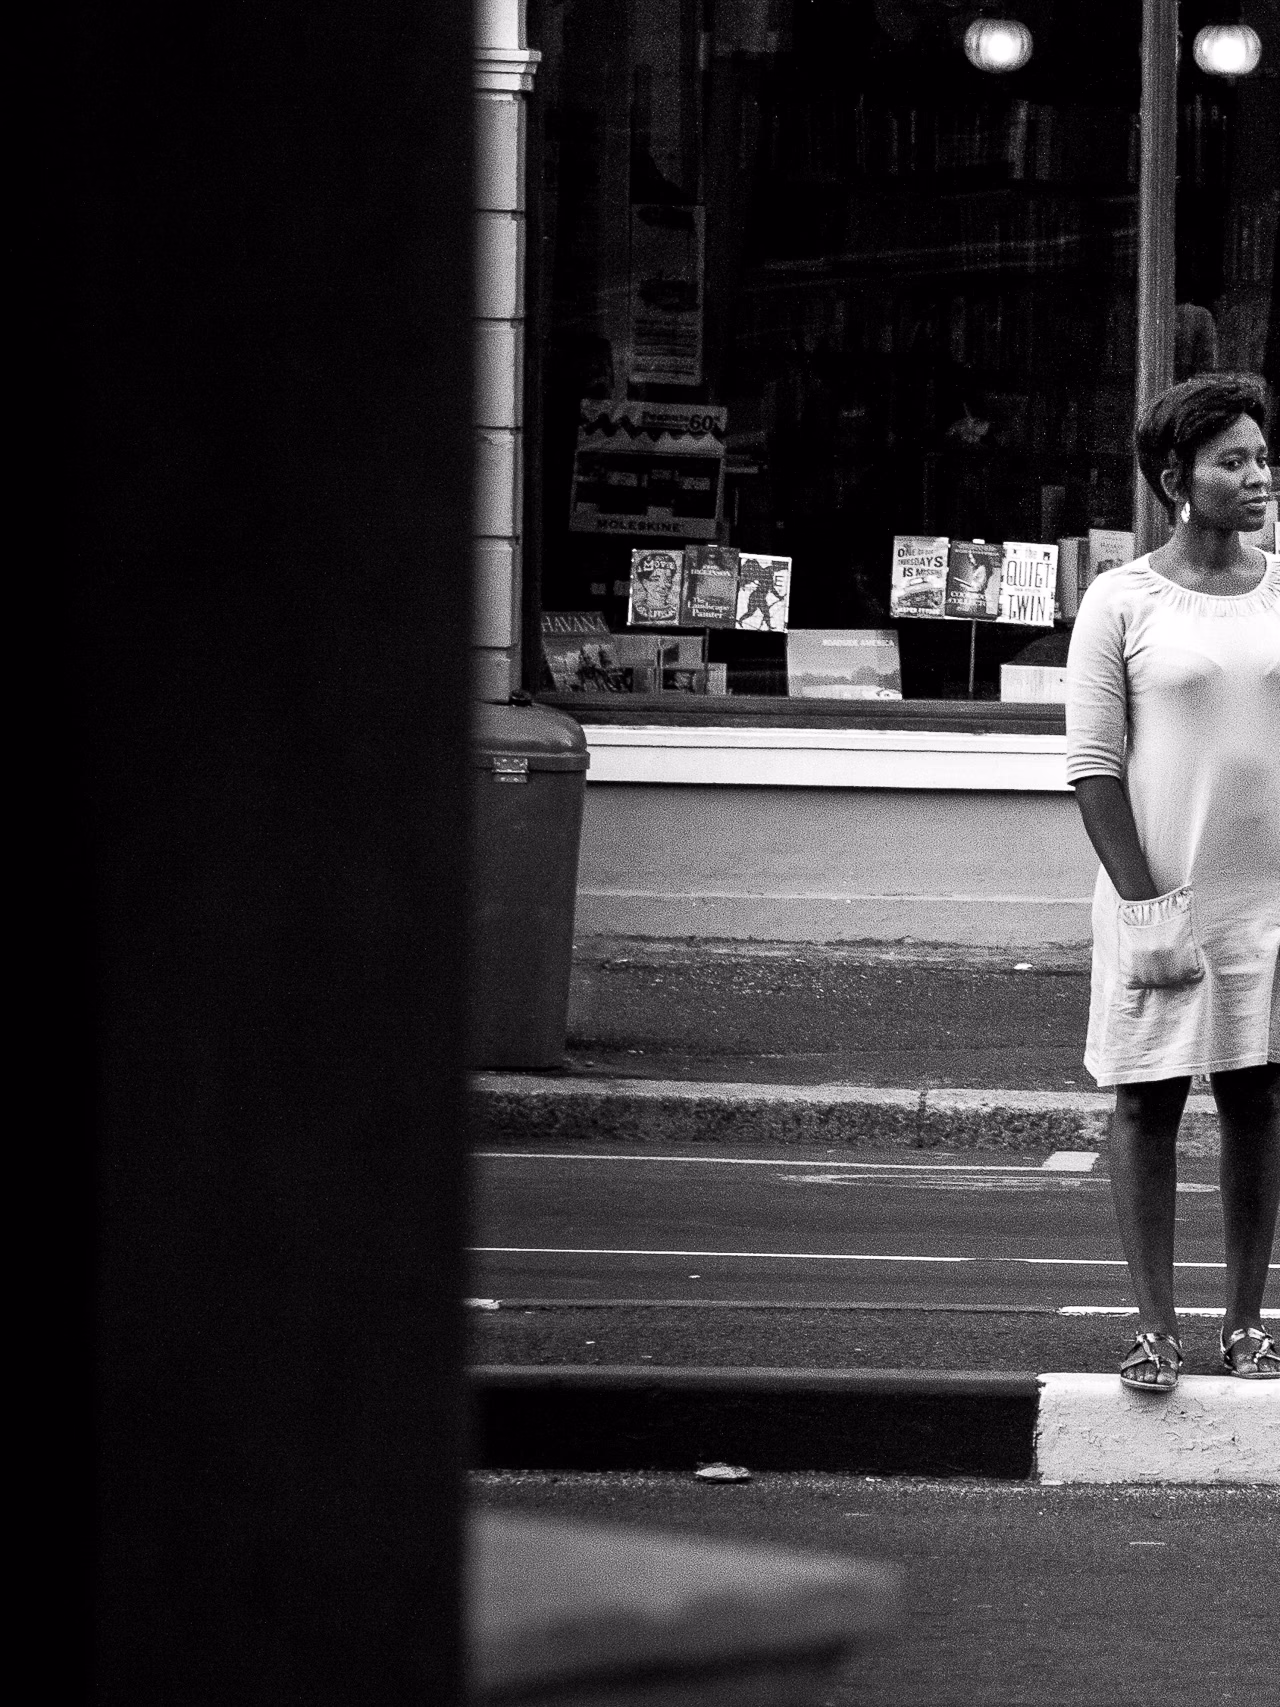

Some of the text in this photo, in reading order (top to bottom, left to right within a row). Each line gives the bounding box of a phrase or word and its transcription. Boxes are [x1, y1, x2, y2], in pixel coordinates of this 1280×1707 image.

[597, 518, 681, 533] MOLESKINE
[902, 567, 914, 578] IS
[1006, 560, 1052, 588] QUIET
[692, 608, 723, 619] Painter
[1008, 594, 1046, 622] TWIN
[540, 615, 608, 632] HAVANA
